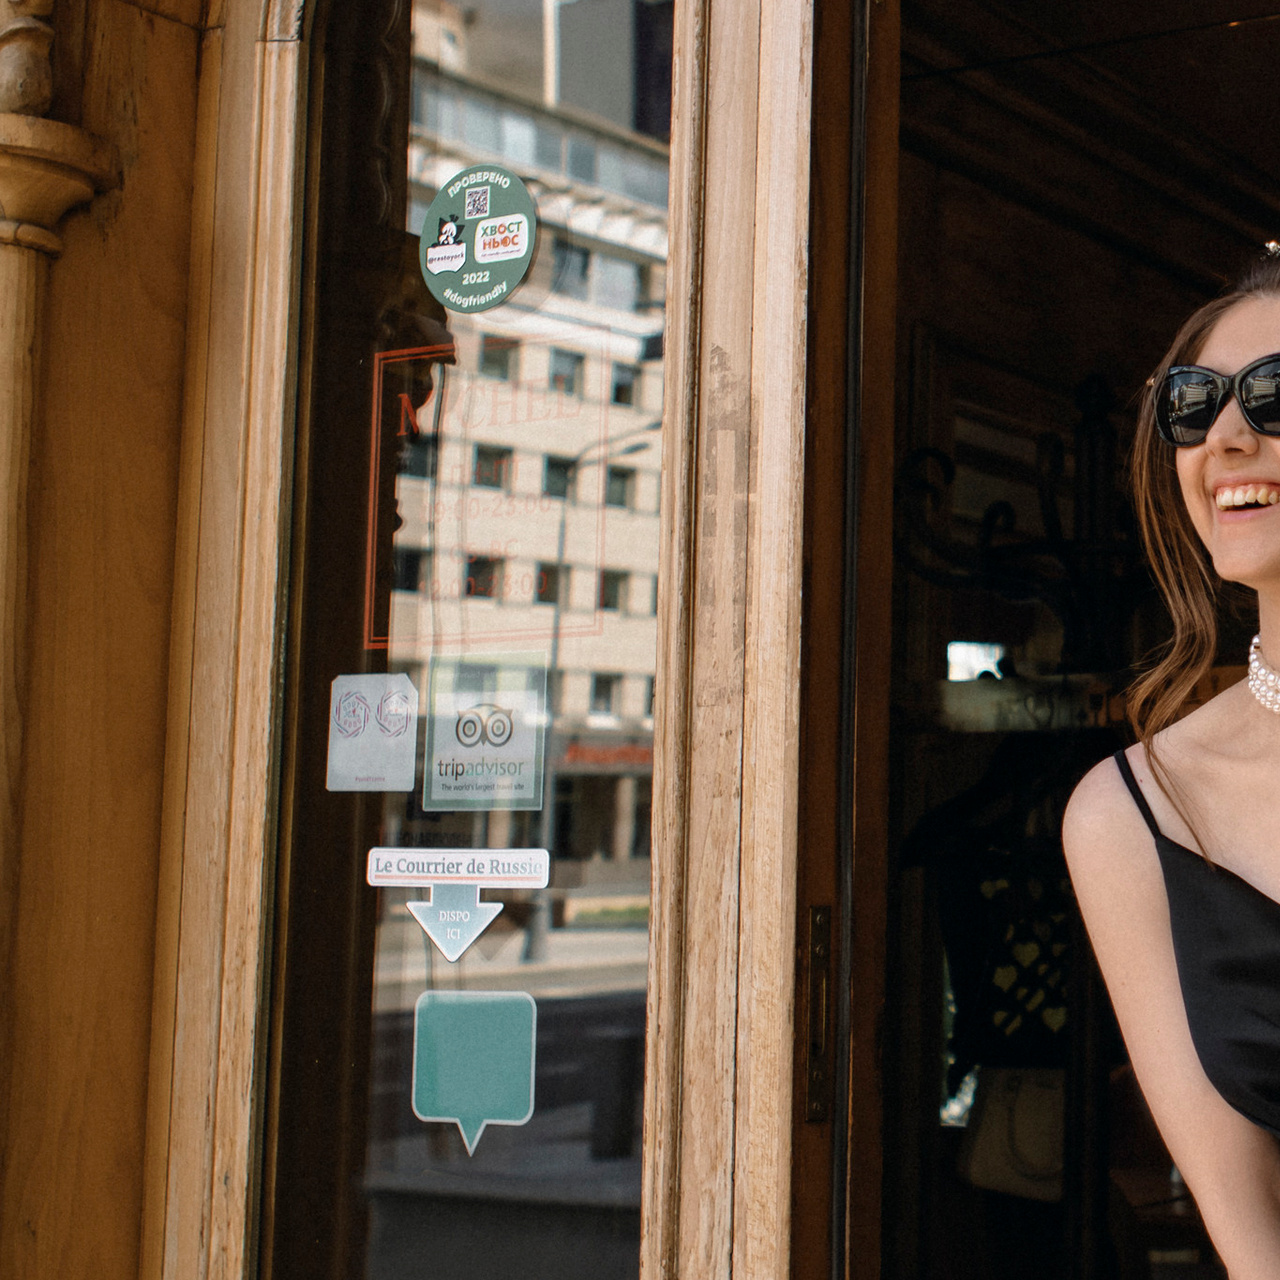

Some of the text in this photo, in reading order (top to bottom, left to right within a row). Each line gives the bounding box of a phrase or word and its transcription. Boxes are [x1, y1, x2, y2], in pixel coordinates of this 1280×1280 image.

[447, 171, 510, 197] ПРОВЕРЕНО
[481, 221, 522, 237] ХВОСТ
[462, 270, 490, 286] 2022
[443, 280, 507, 308] #dogfriendly
[437, 757, 524, 781] tripadvisor
[441, 783, 452, 791] The
[375, 857, 542, 875] Le Courrier de Russie
[439, 910, 470, 922] DISPO
[446, 928, 460, 939] ICI
